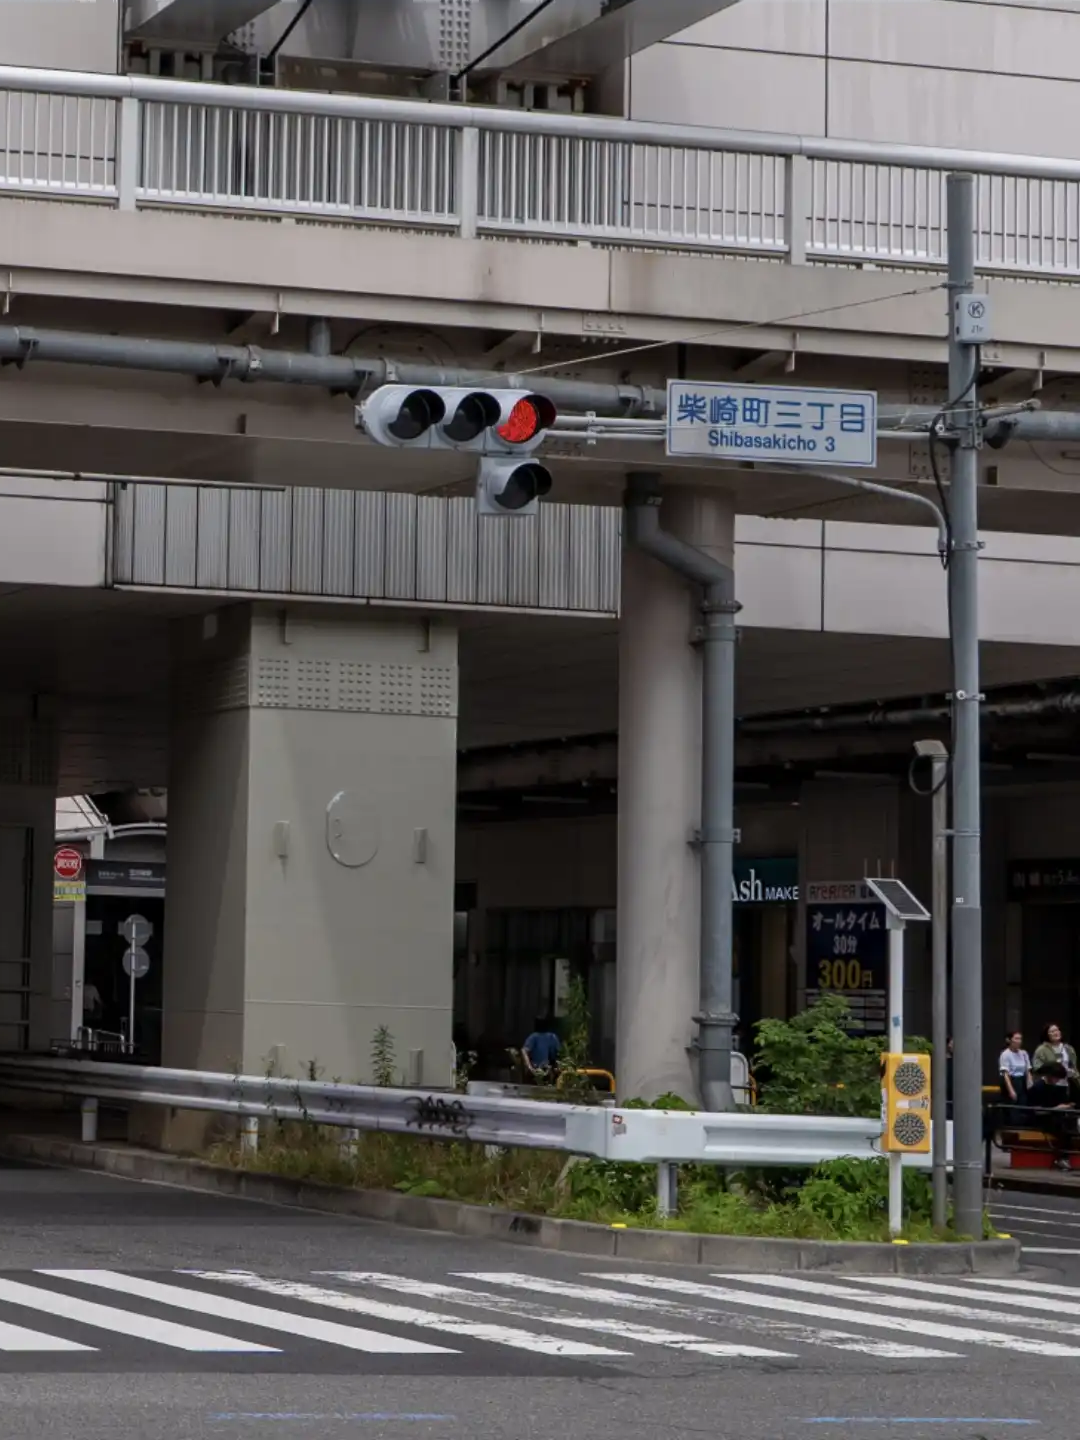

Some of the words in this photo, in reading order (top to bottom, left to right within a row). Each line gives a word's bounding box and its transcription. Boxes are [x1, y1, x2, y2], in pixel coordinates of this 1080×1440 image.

[676, 392, 866, 433] 柴崎町三丁目
[707, 429, 817, 452] Shibasakicho
[824, 436, 836, 453] 3
[765, 885, 800, 901] MAKE
[812, 910, 880, 931] オールタイム
[833, 934, 858, 954] 30分
[818, 959, 873, 989] 300円
